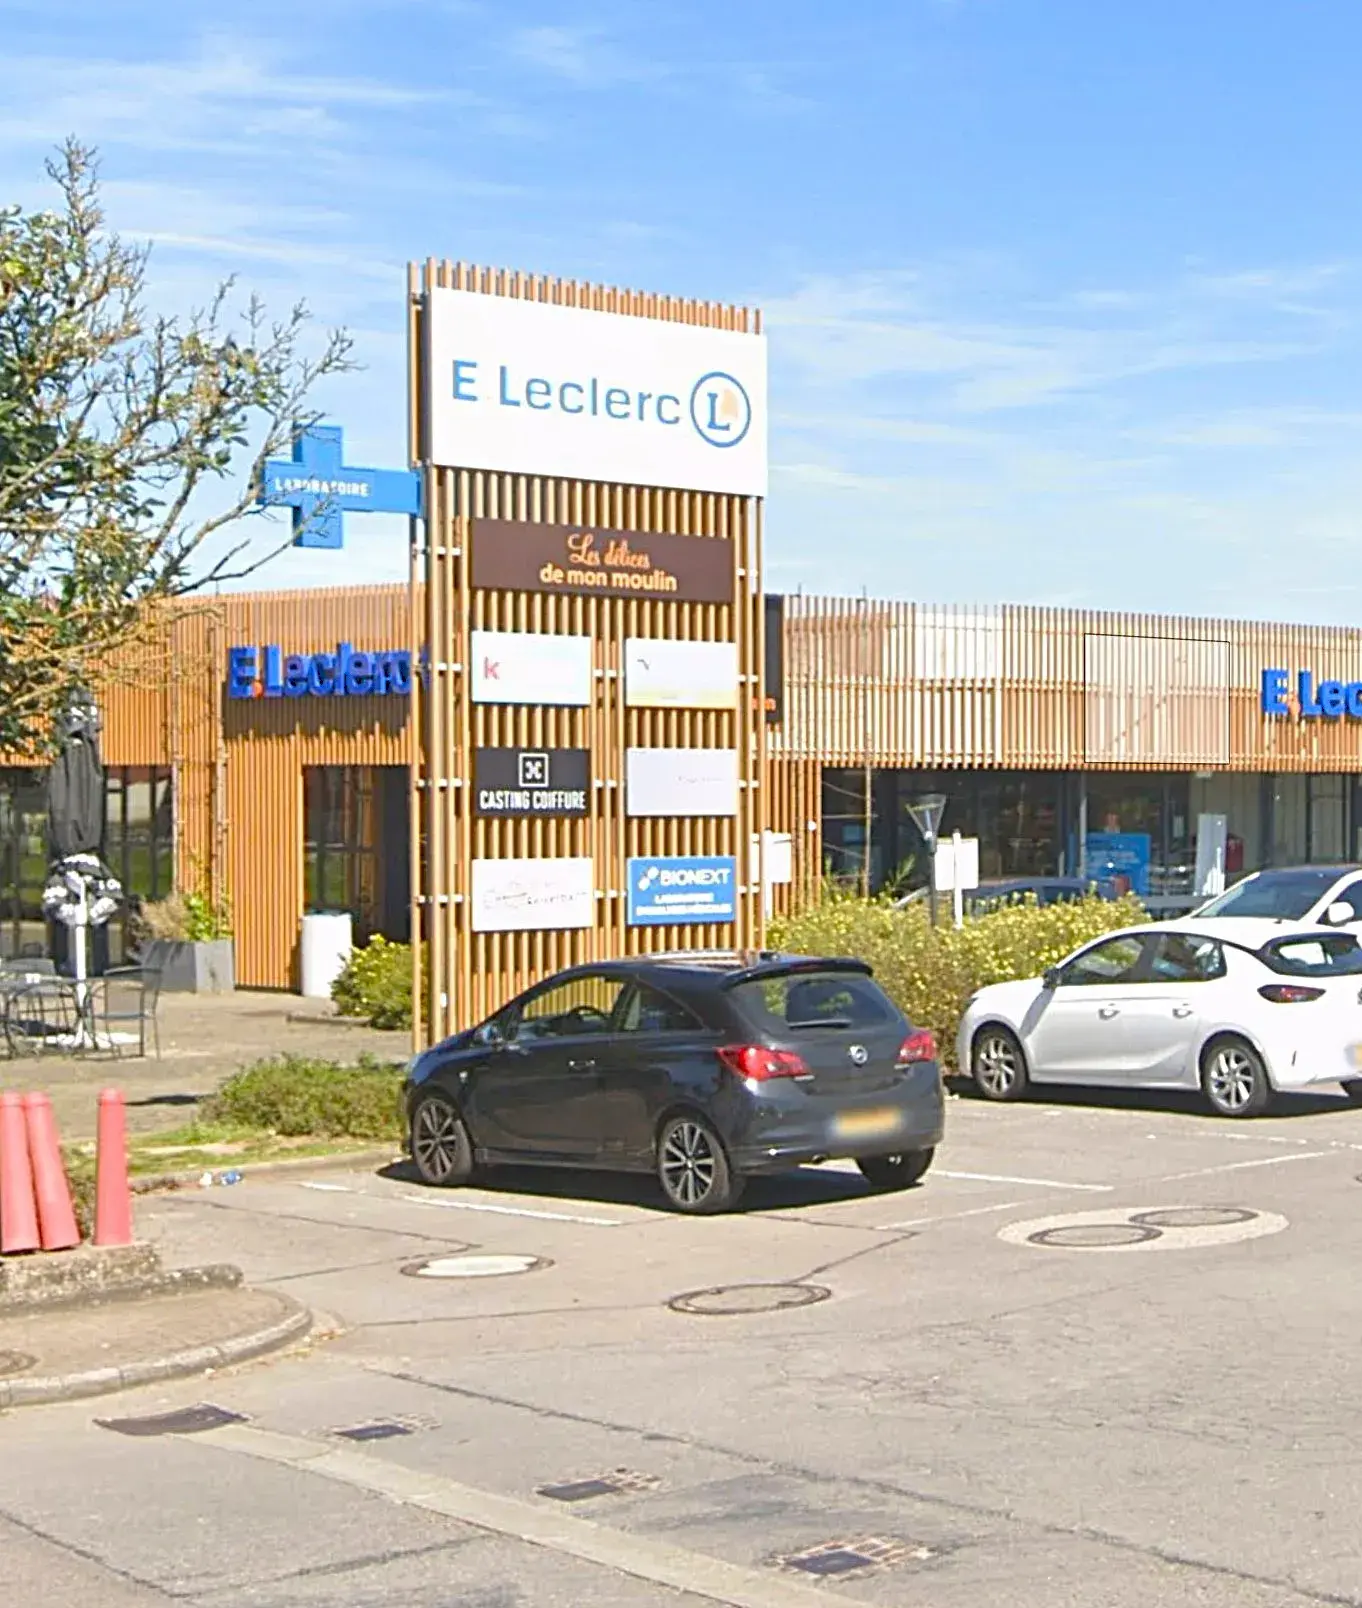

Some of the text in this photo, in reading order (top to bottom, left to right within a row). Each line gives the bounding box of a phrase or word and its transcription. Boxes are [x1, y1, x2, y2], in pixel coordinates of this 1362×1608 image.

[499, 365, 681, 424] Leclerc
[567, 533, 600, 566] Les
[539, 562, 678, 592] de mon moulin
[479, 790, 586, 810] CASTING COIFFURE
[659, 868, 732, 887] BIONEXT
